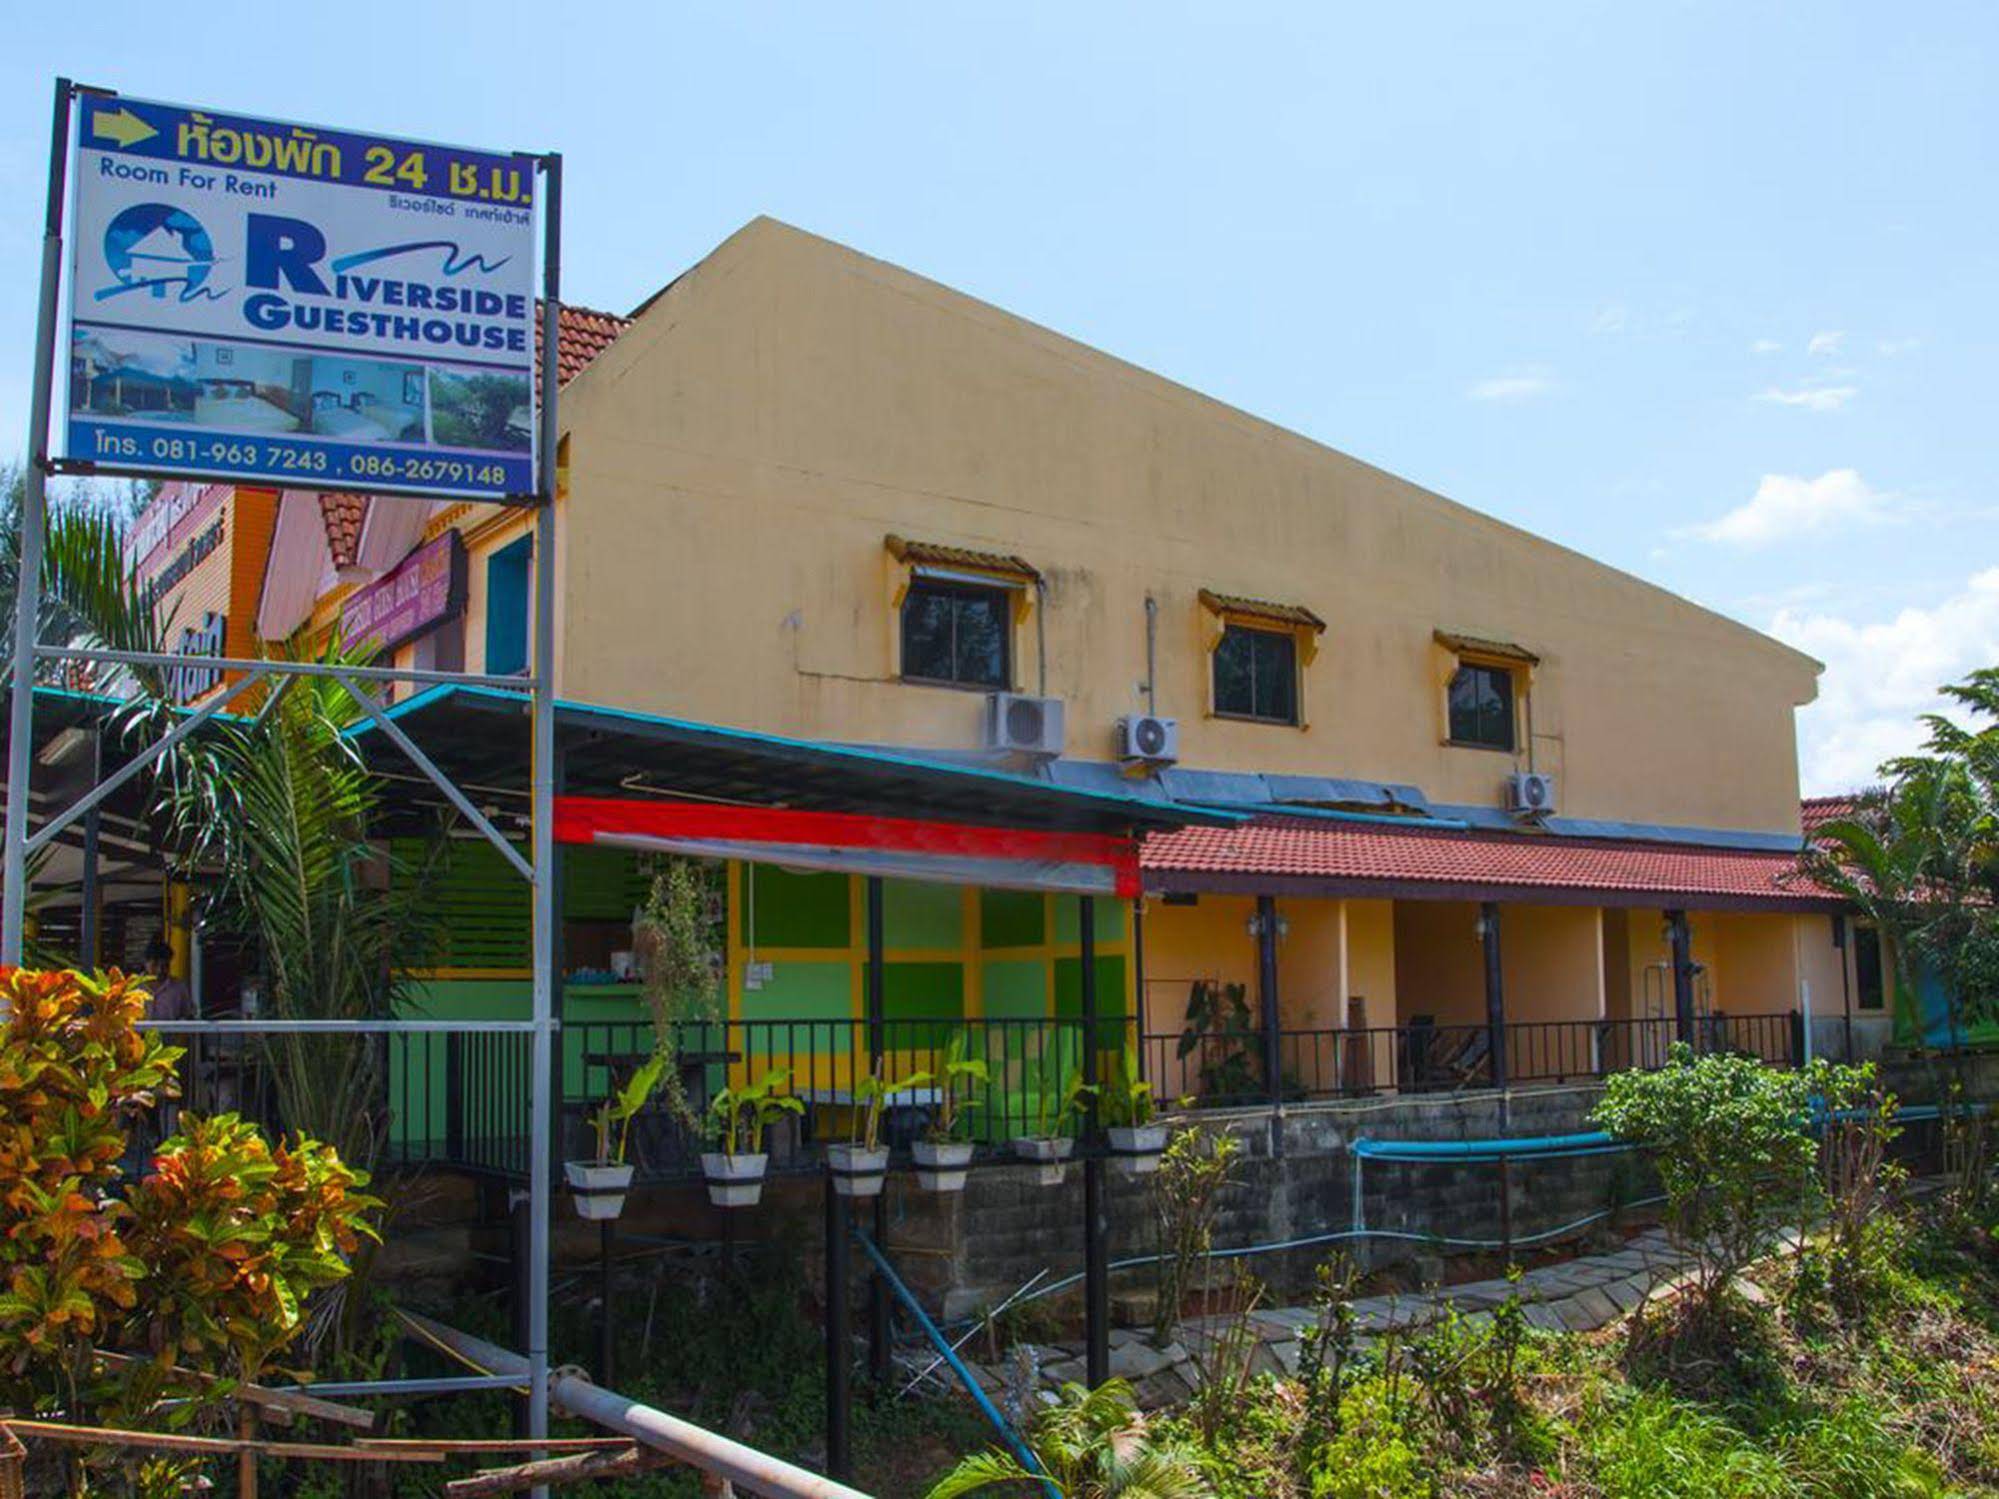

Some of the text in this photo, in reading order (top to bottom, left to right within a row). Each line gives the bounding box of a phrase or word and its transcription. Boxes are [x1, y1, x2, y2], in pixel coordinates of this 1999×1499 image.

[100, 157, 277, 199] Room For Rent
[177, 111, 533, 204] ห้องพัก 24 ช.ม.
[246, 212, 527, 320] RIVERSIDE
[243, 293, 527, 352] GUESTHOUSE
[153, 437, 257, 466] 081-963
[266, 446, 327, 473] 7243
[351, 454, 506, 486] 086-2679148
